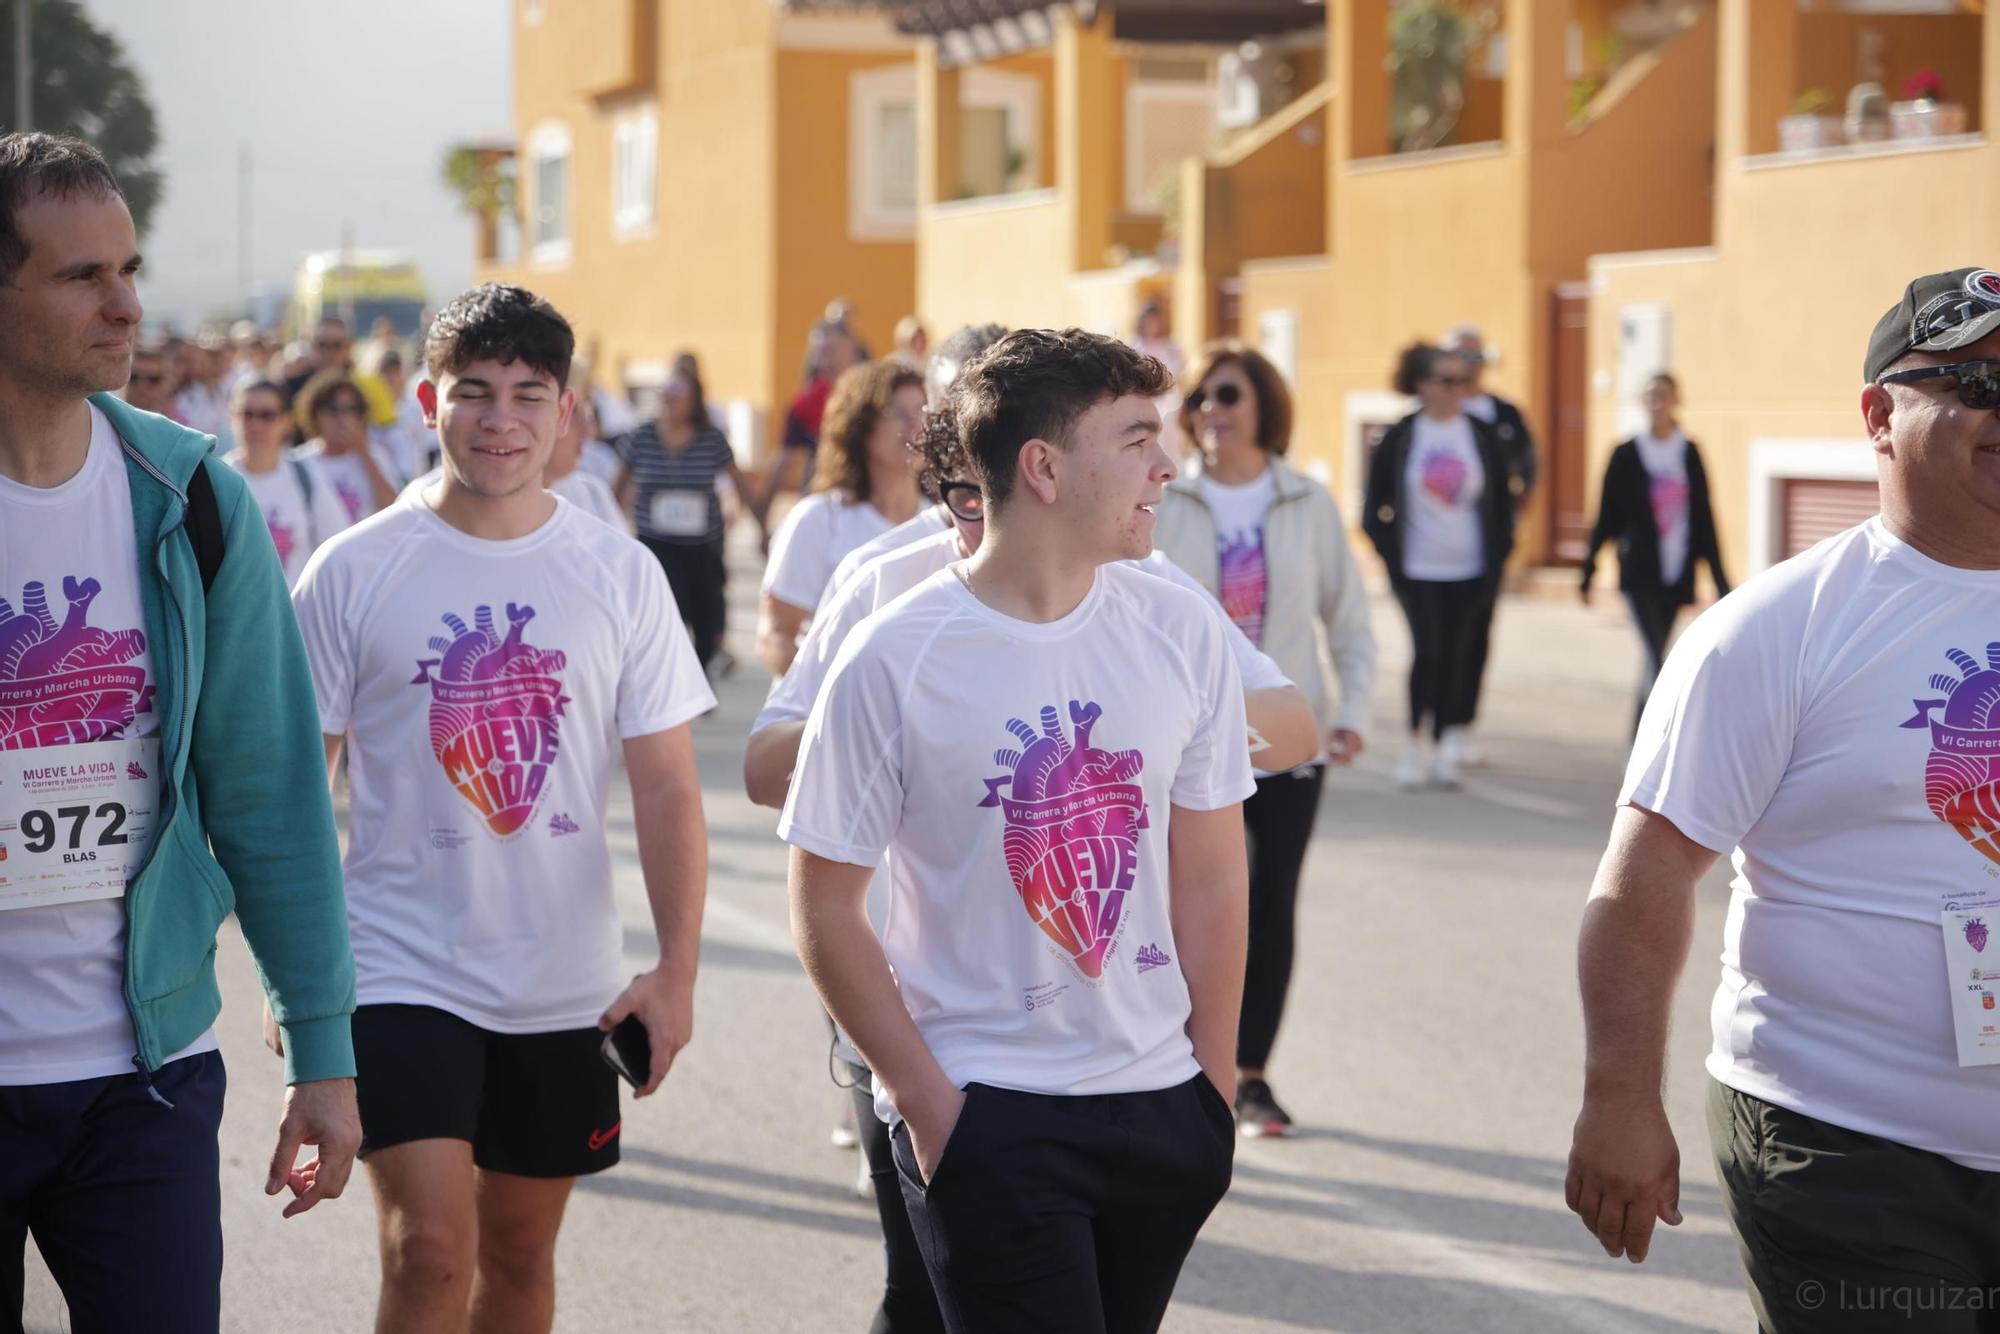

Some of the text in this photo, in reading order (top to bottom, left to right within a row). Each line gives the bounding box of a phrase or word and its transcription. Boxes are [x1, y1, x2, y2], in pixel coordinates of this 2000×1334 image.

[35, 687, 42, 698] y
[45, 679, 90, 694] Marcha
[93, 674, 136, 685] Urbana
[1942, 734, 1953, 745] VI
[442, 716, 558, 786] MUEVE
[23, 767, 67, 781] MUEVE
[71, 764, 86, 777] LA
[88, 762, 115, 775] VIDA
[31, 780, 59, 789] Carrera
[66, 776, 93, 785] Marcha
[1012, 808, 1022, 819] VI
[1024, 806, 1060, 820] Carrera
[1062, 805, 1069, 816] y
[1097, 791, 1136, 803] Urbana
[21, 802, 128, 853] 972
[63, 851, 97, 864] BLAS
[1022, 837, 1137, 924] MUEVE
[1137, 943, 1170, 961] ALGAR
[1968, 985, 1984, 993] XXL
